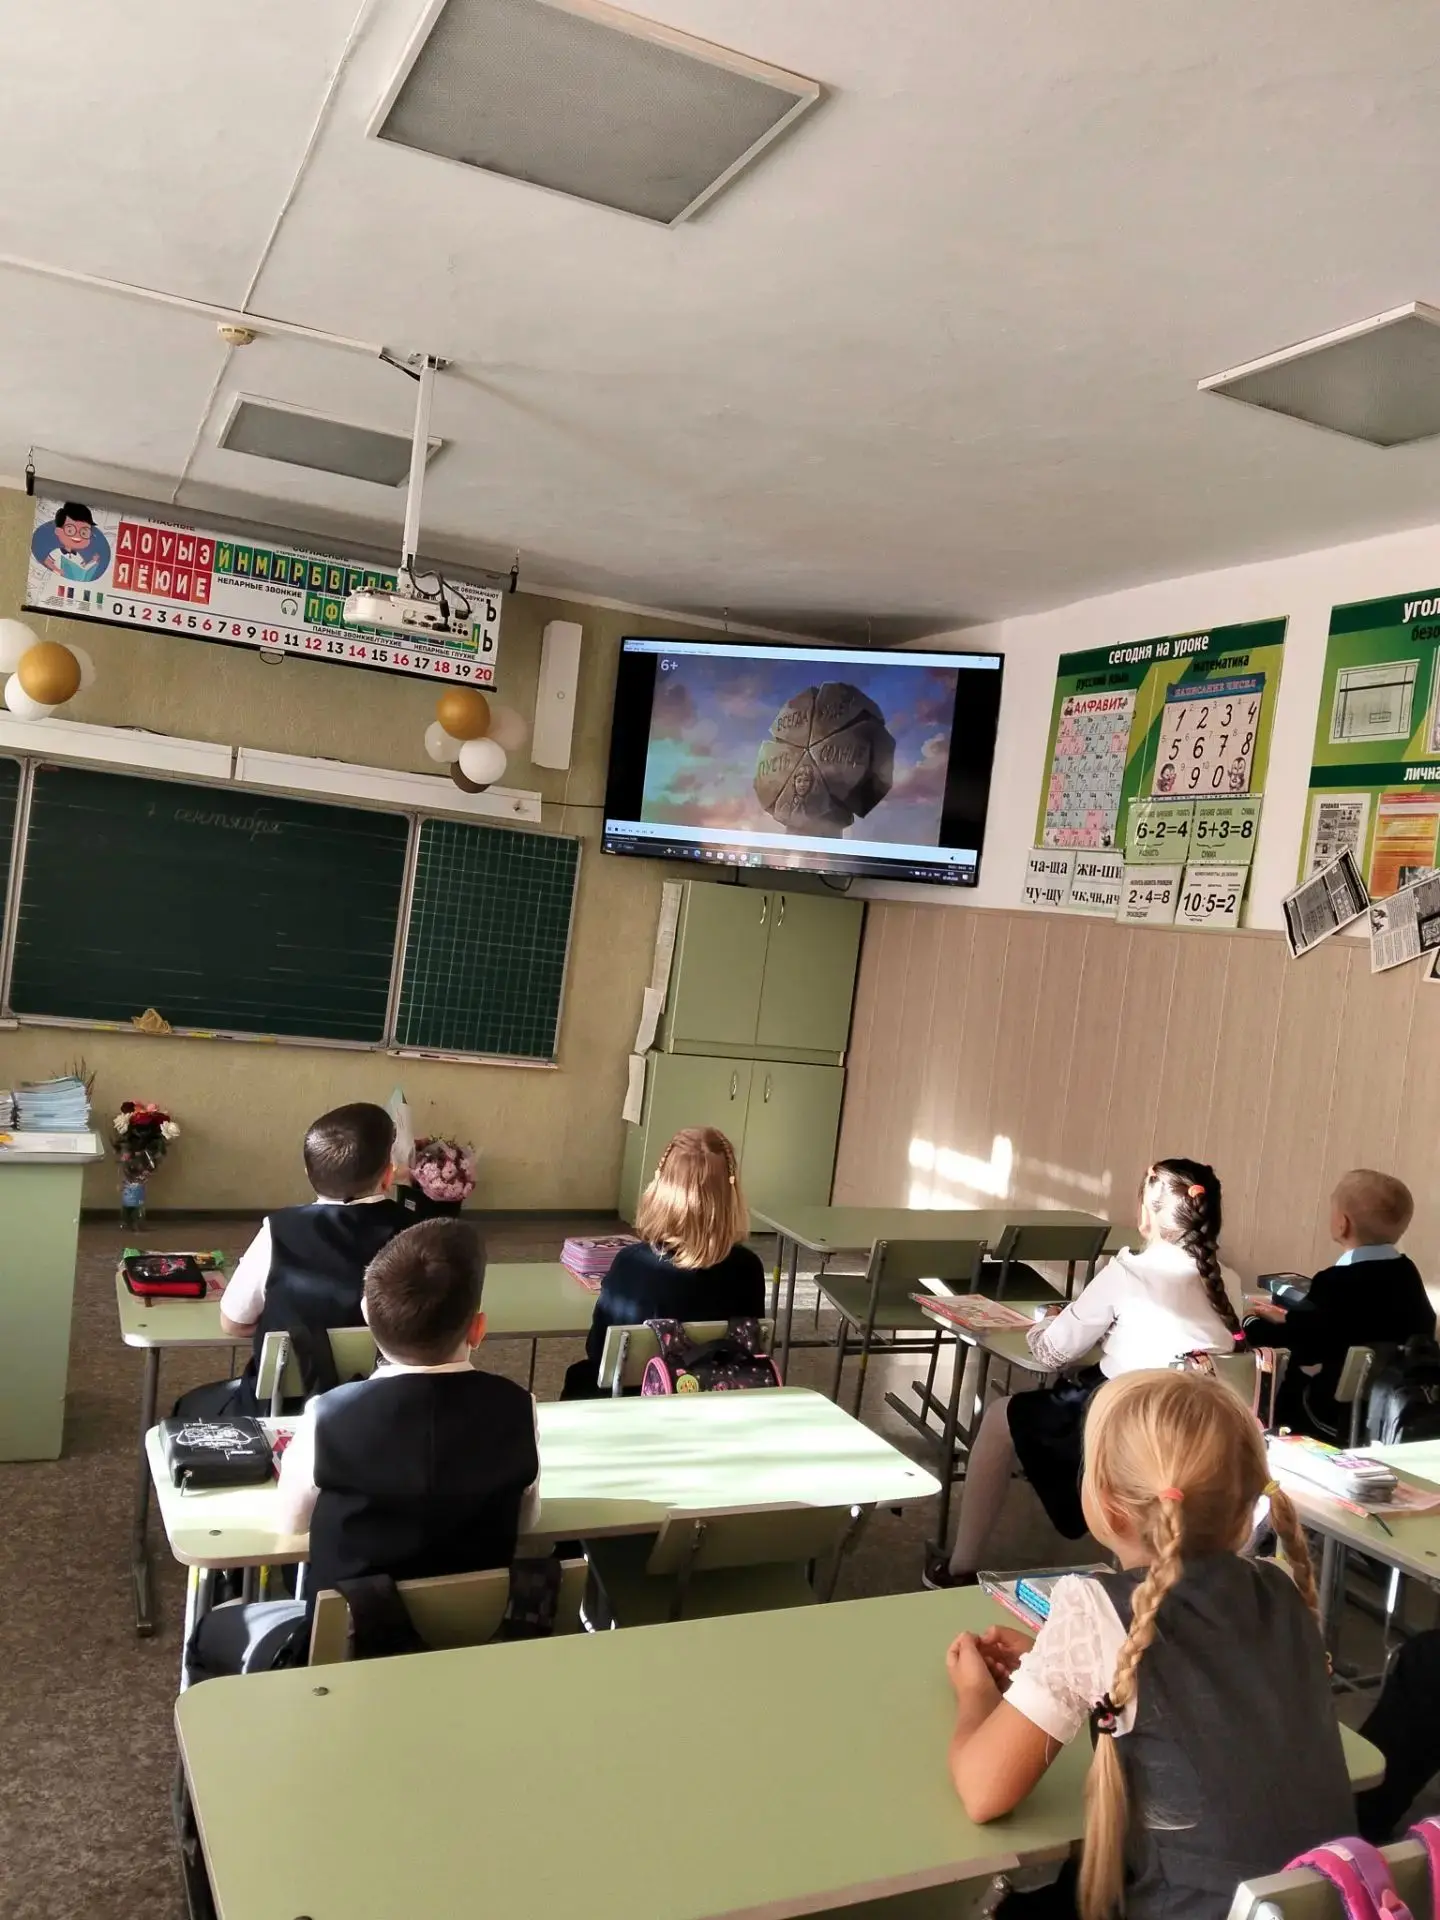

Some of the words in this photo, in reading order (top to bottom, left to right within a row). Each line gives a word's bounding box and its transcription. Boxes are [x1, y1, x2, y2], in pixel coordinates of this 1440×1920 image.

[120, 530, 132, 550] А
[141, 533, 152, 554] О
[161, 536, 172, 557] У
[178, 541, 193, 561] Ы
[199, 545, 210, 565] Э
[118, 563, 129, 583] Я
[138, 565, 149, 589] Ё
[155, 570, 170, 591] Ю
[176, 574, 187, 594] И
[196, 578, 207, 598] Е
[237, 551, 248, 572] Н
[255, 555, 269, 576] М
[274, 558, 286, 578] Л
[293, 562, 304, 583] Р
[311, 565, 322, 586] Б
[329, 569, 340, 590] В
[217, 576, 263, 591] НЕПАРНЫЕ
[264, 585, 303, 599] ЗВОНКИЕ
[128, 606, 136, 618] 1
[142, 608, 152, 621] 2
[157, 611, 167, 623] 3
[172, 613, 182, 626] 4
[187, 616, 197, 628] 5
[202, 618, 212, 631] 6
[218, 621, 227, 633] 7
[231, 624, 241, 636] 8
[247, 626, 256, 638] 9
[261, 629, 279, 643] 10
[284, 633, 299, 646] 11
[305, 637, 322, 650] 12
[327, 641, 344, 654] 13
[349, 645, 367, 658] 14
[371, 649, 388, 662] 15
[393, 653, 409, 666] 16
[414, 656, 430, 669] 17
[434, 660, 450, 673] 18
[455, 664, 471, 677] 19
[474, 667, 492, 681] 20
[313, 625, 342, 637] ПАРНЫЕ
[1108, 644, 1152, 665] сегодня
[1156, 641, 1170, 657] на
[1172, 635, 1209, 657] уроке
[660, 659, 678, 671] 6+
[1073, 697, 1123, 714] АЛФАВИТ
[1176, 708, 1187, 732] 1
[1196, 706, 1209, 729] 2
[1221, 704, 1233, 726] 3
[1248, 701, 1257, 724] 4
[1169, 739, 1181, 760] 5
[1193, 737, 1205, 759] 6
[1219, 734, 1229, 758] 7
[1241, 732, 1253, 755] 8
[1188, 766, 1200, 789] 9
[1197, 820, 1253, 839] 5+3=8
